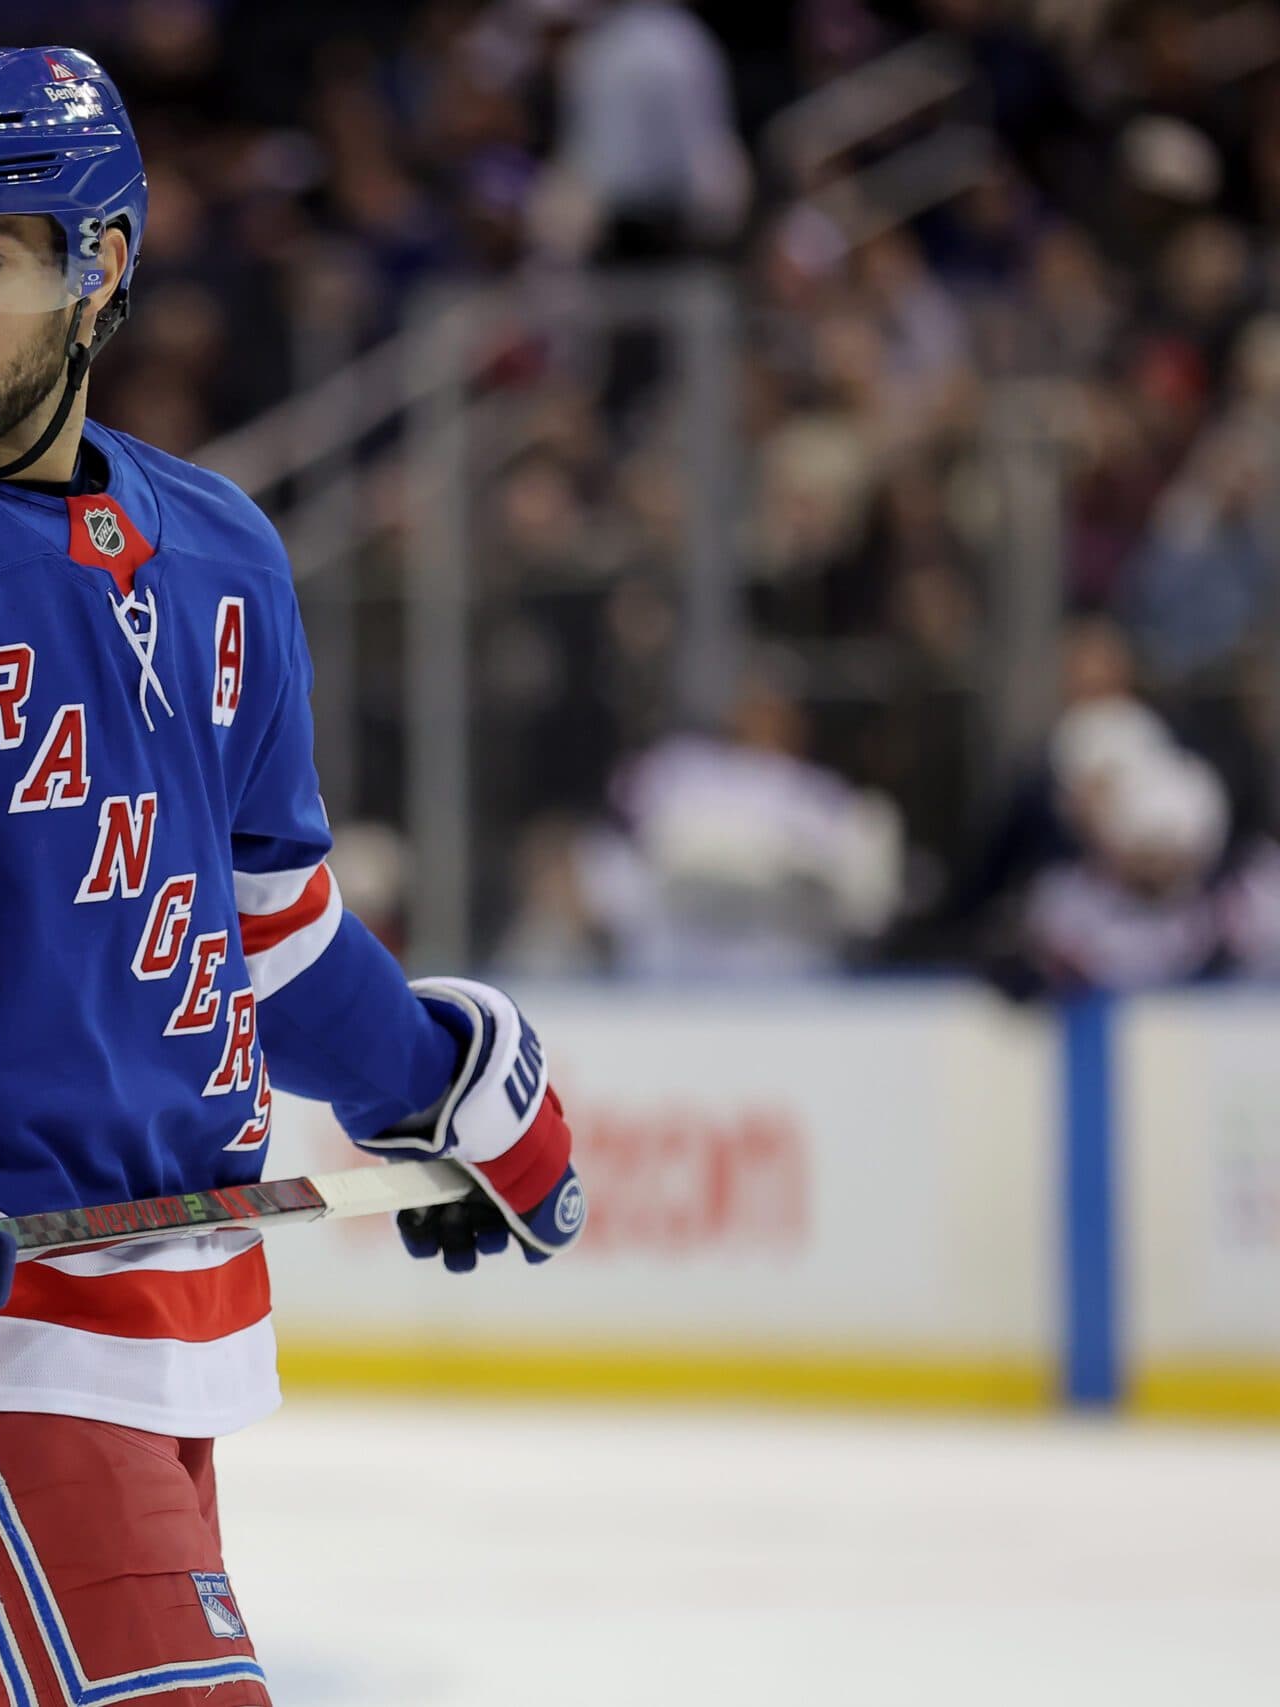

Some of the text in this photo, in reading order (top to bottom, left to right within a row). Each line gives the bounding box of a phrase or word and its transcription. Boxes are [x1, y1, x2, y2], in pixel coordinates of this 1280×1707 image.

[43, 85, 101, 103] Benjn
[64, 102, 104, 119] More
[98, 521, 113, 545] NHL
[211, 596, 245, 727] A
